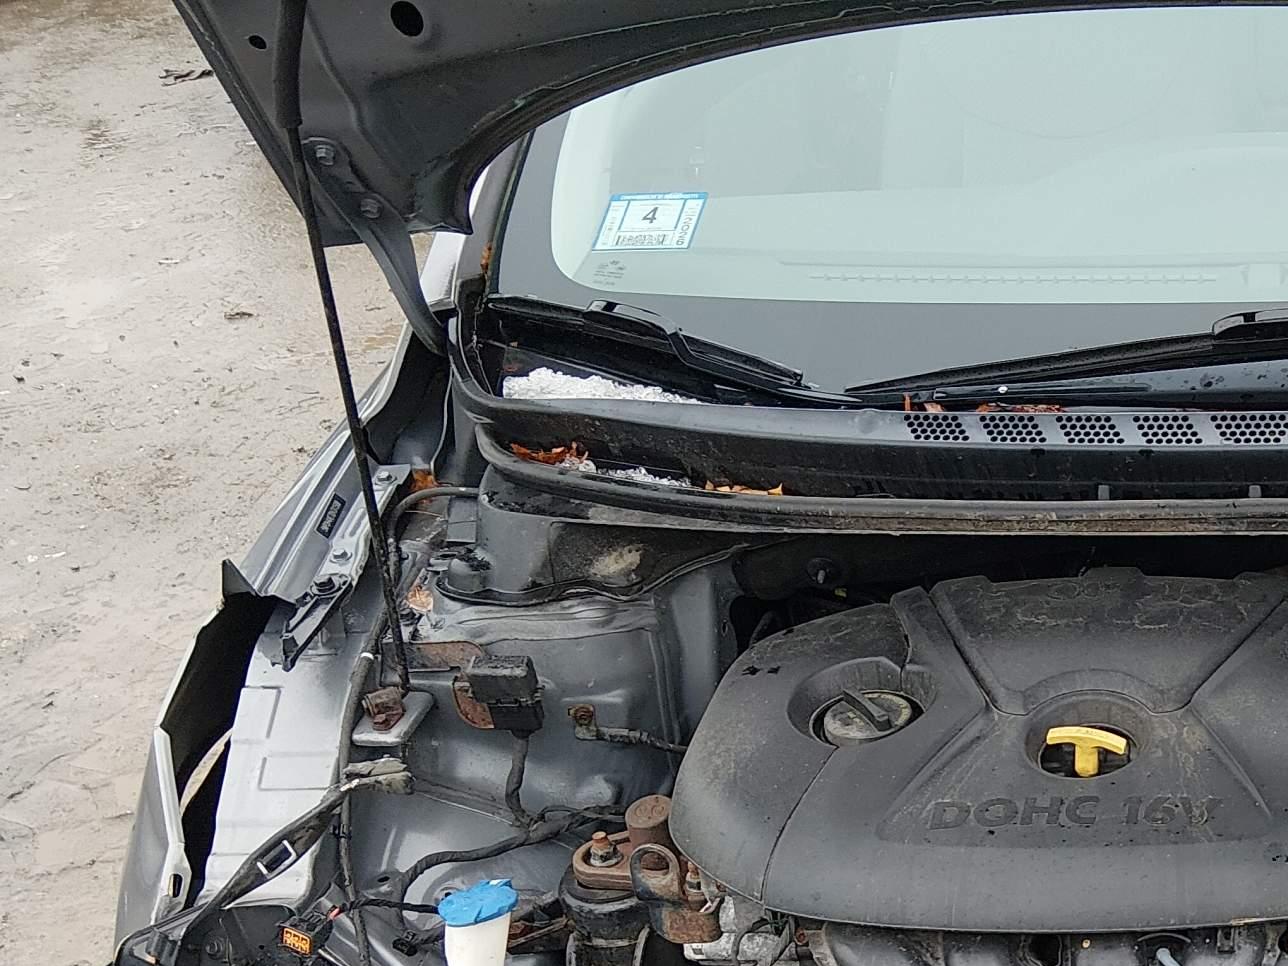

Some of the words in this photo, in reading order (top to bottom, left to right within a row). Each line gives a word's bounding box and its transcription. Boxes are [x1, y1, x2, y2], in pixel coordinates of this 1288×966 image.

[642, 206, 660, 224] 4
[929, 795, 1101, 830] DOHC
[1121, 795, 1224, 827] 16V
